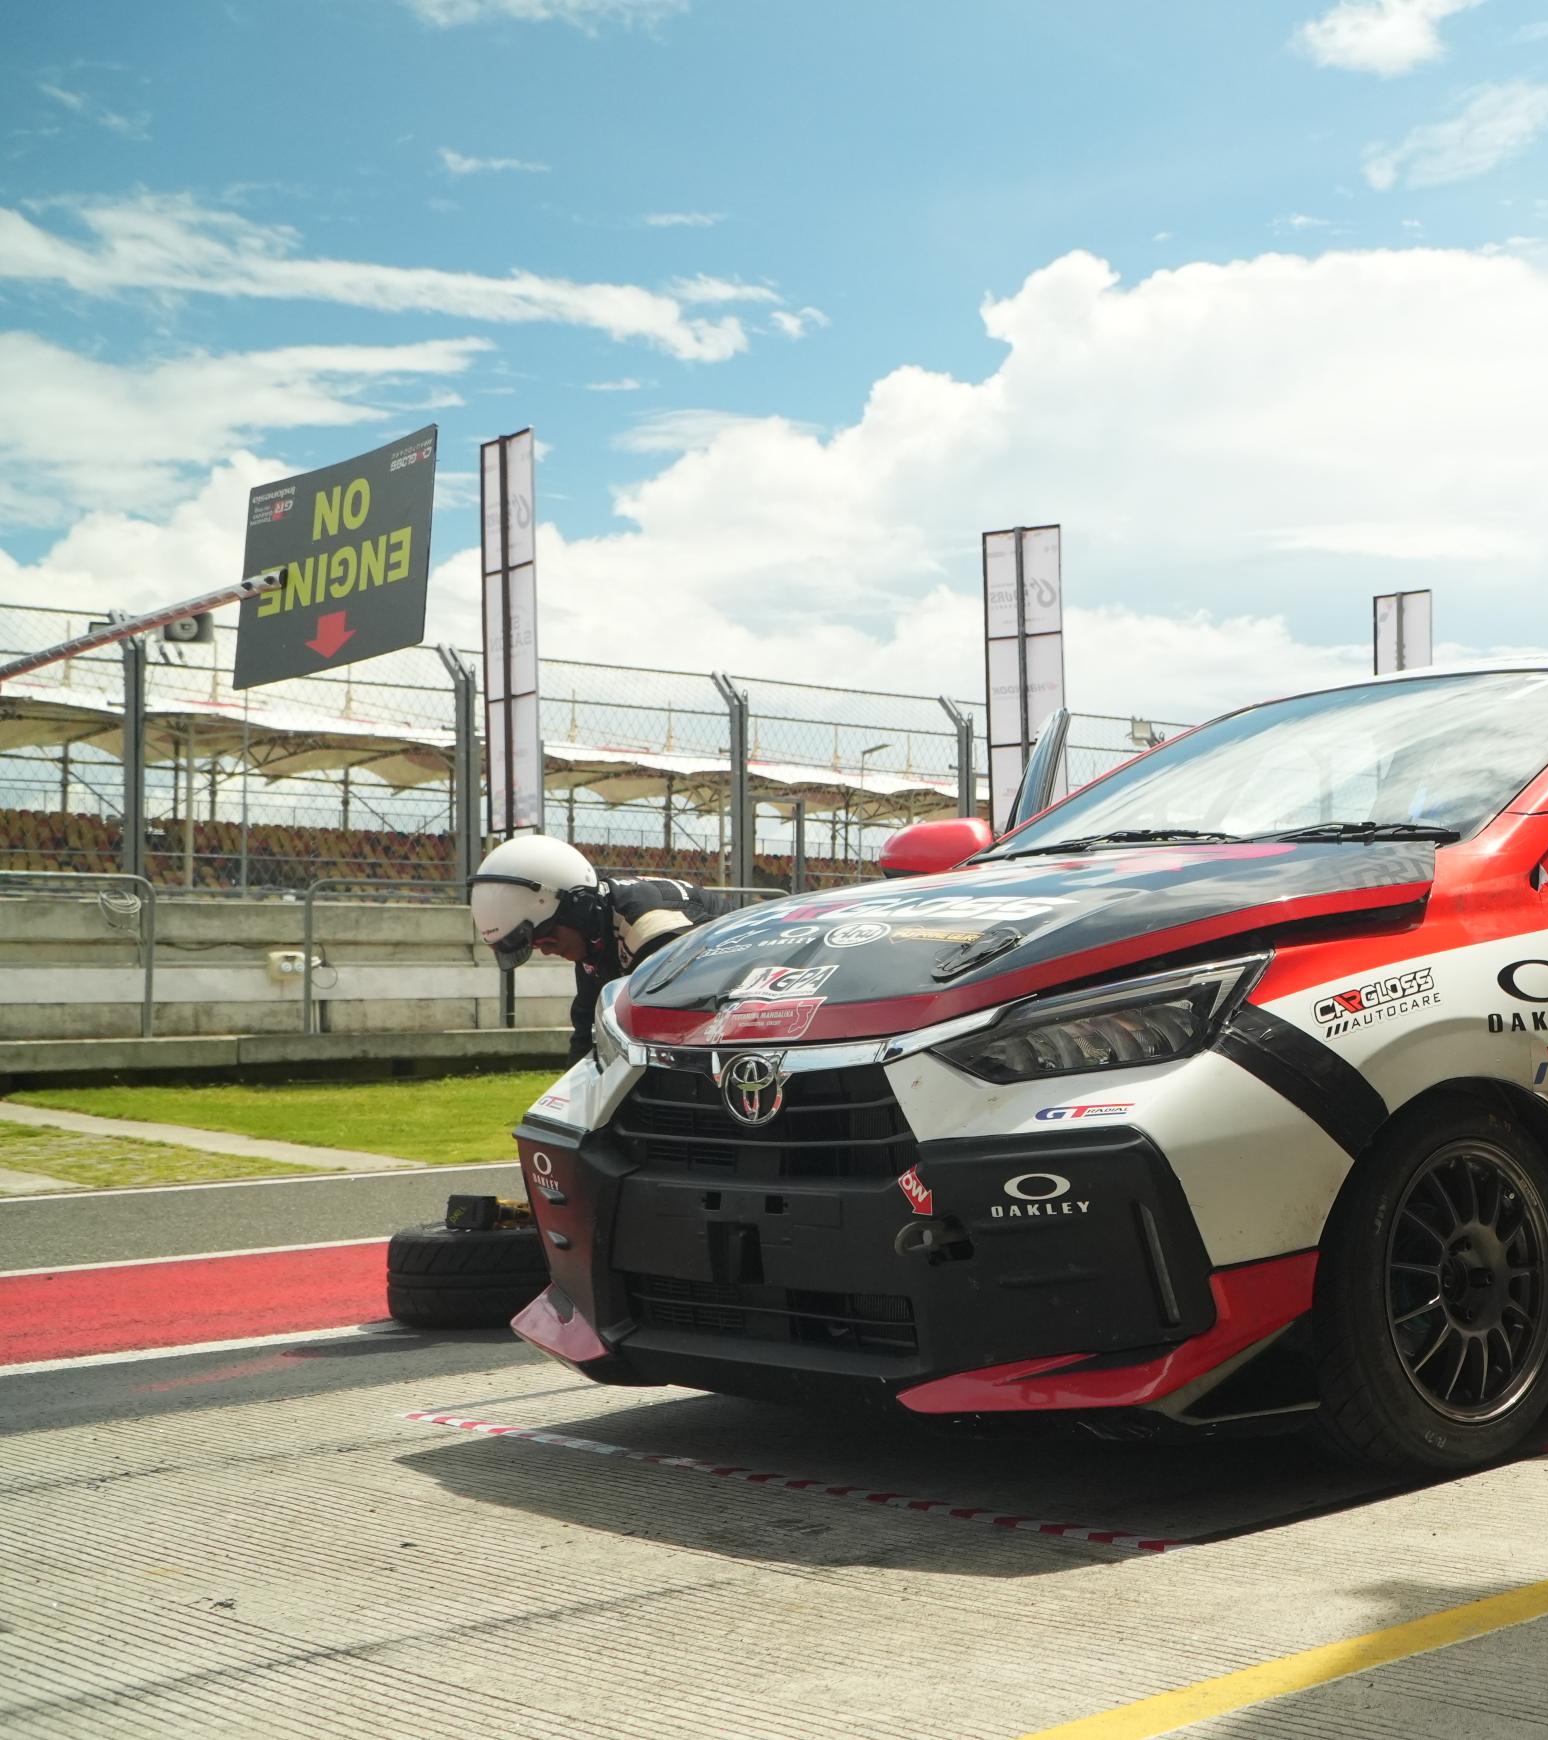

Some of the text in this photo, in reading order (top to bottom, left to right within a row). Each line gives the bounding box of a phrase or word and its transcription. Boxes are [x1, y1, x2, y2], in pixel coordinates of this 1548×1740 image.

[257, 478, 412, 617] ENGINE ON
[758, 937, 816, 947] OAKLEY
[1313, 967, 1435, 1024] CARGLOSS
[1351, 992, 1441, 1029] AUTOCARE
[1087, 1106, 1129, 1114] RADIAL
[532, 1173, 559, 1191] OAKLEY
[901, 1171, 928, 1202] OW
[991, 1201, 1090, 1218] OAKLEY
